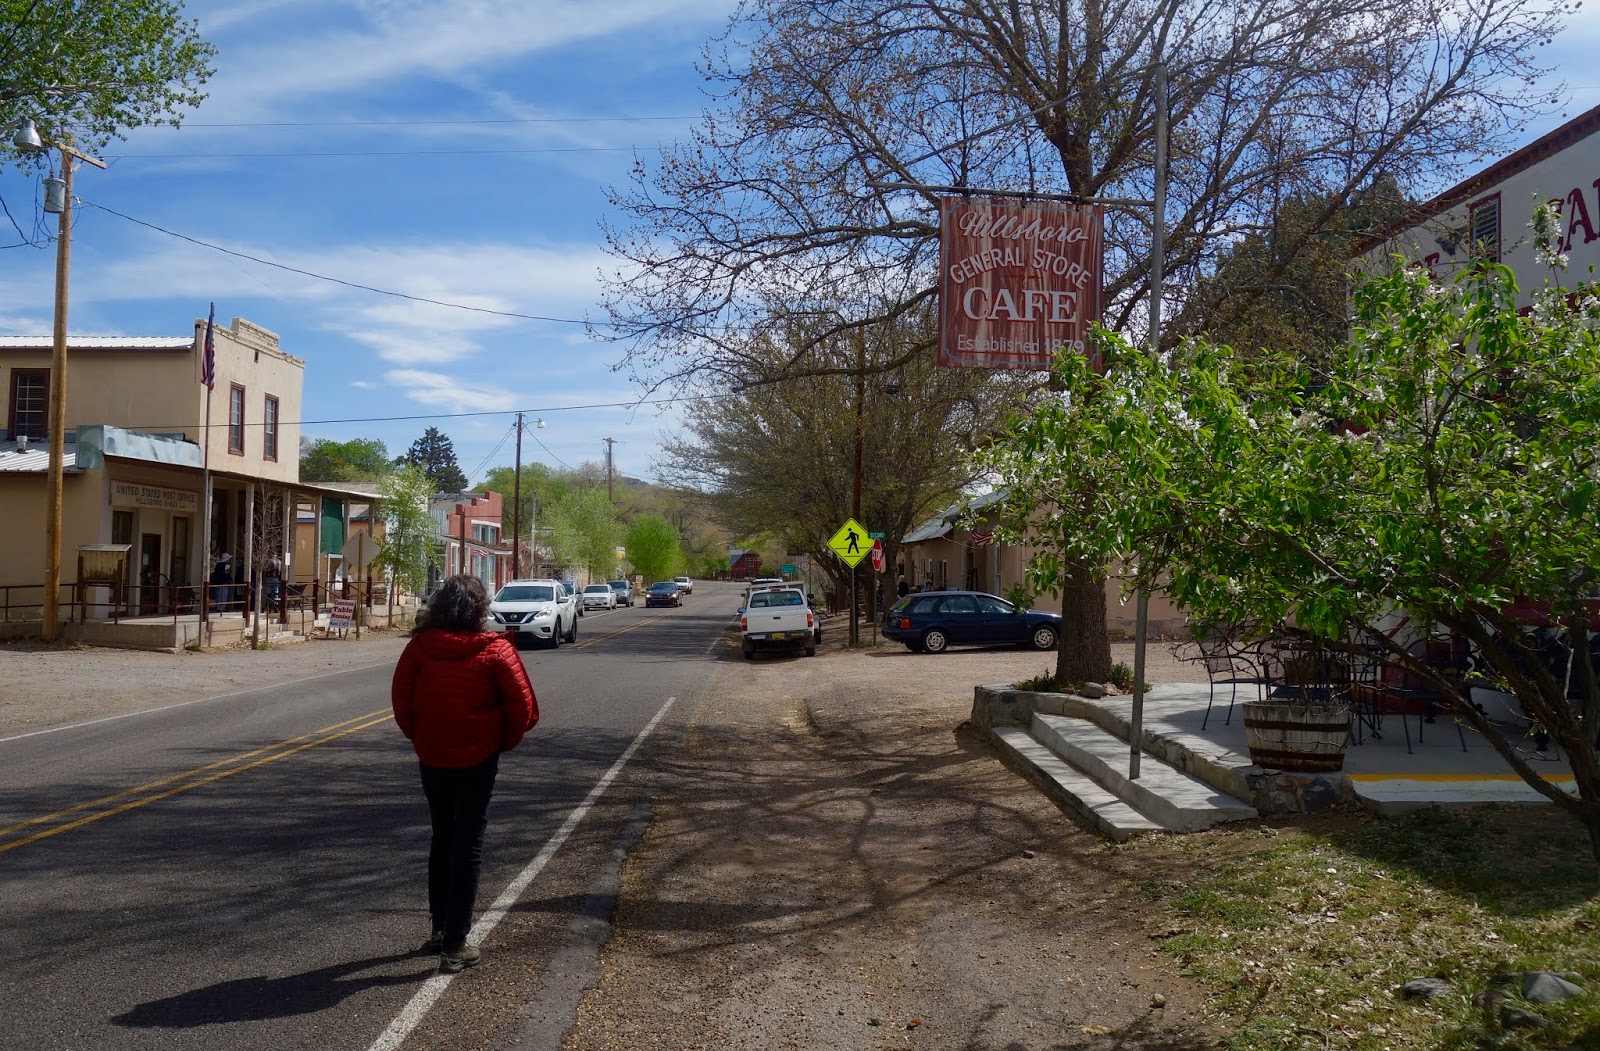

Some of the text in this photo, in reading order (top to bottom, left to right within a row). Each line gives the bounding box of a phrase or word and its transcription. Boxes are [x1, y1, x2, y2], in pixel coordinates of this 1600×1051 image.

[959, 211, 1089, 243] Hillsboro
[950, 246, 1092, 290] GENERAL STORE
[963, 286, 1077, 323] CAFE
[957, 334, 1085, 356] Established 1879
[116, 485, 195, 503] UNITED STATES POST OFFICE
[872, 548, 882, 561] STOP
